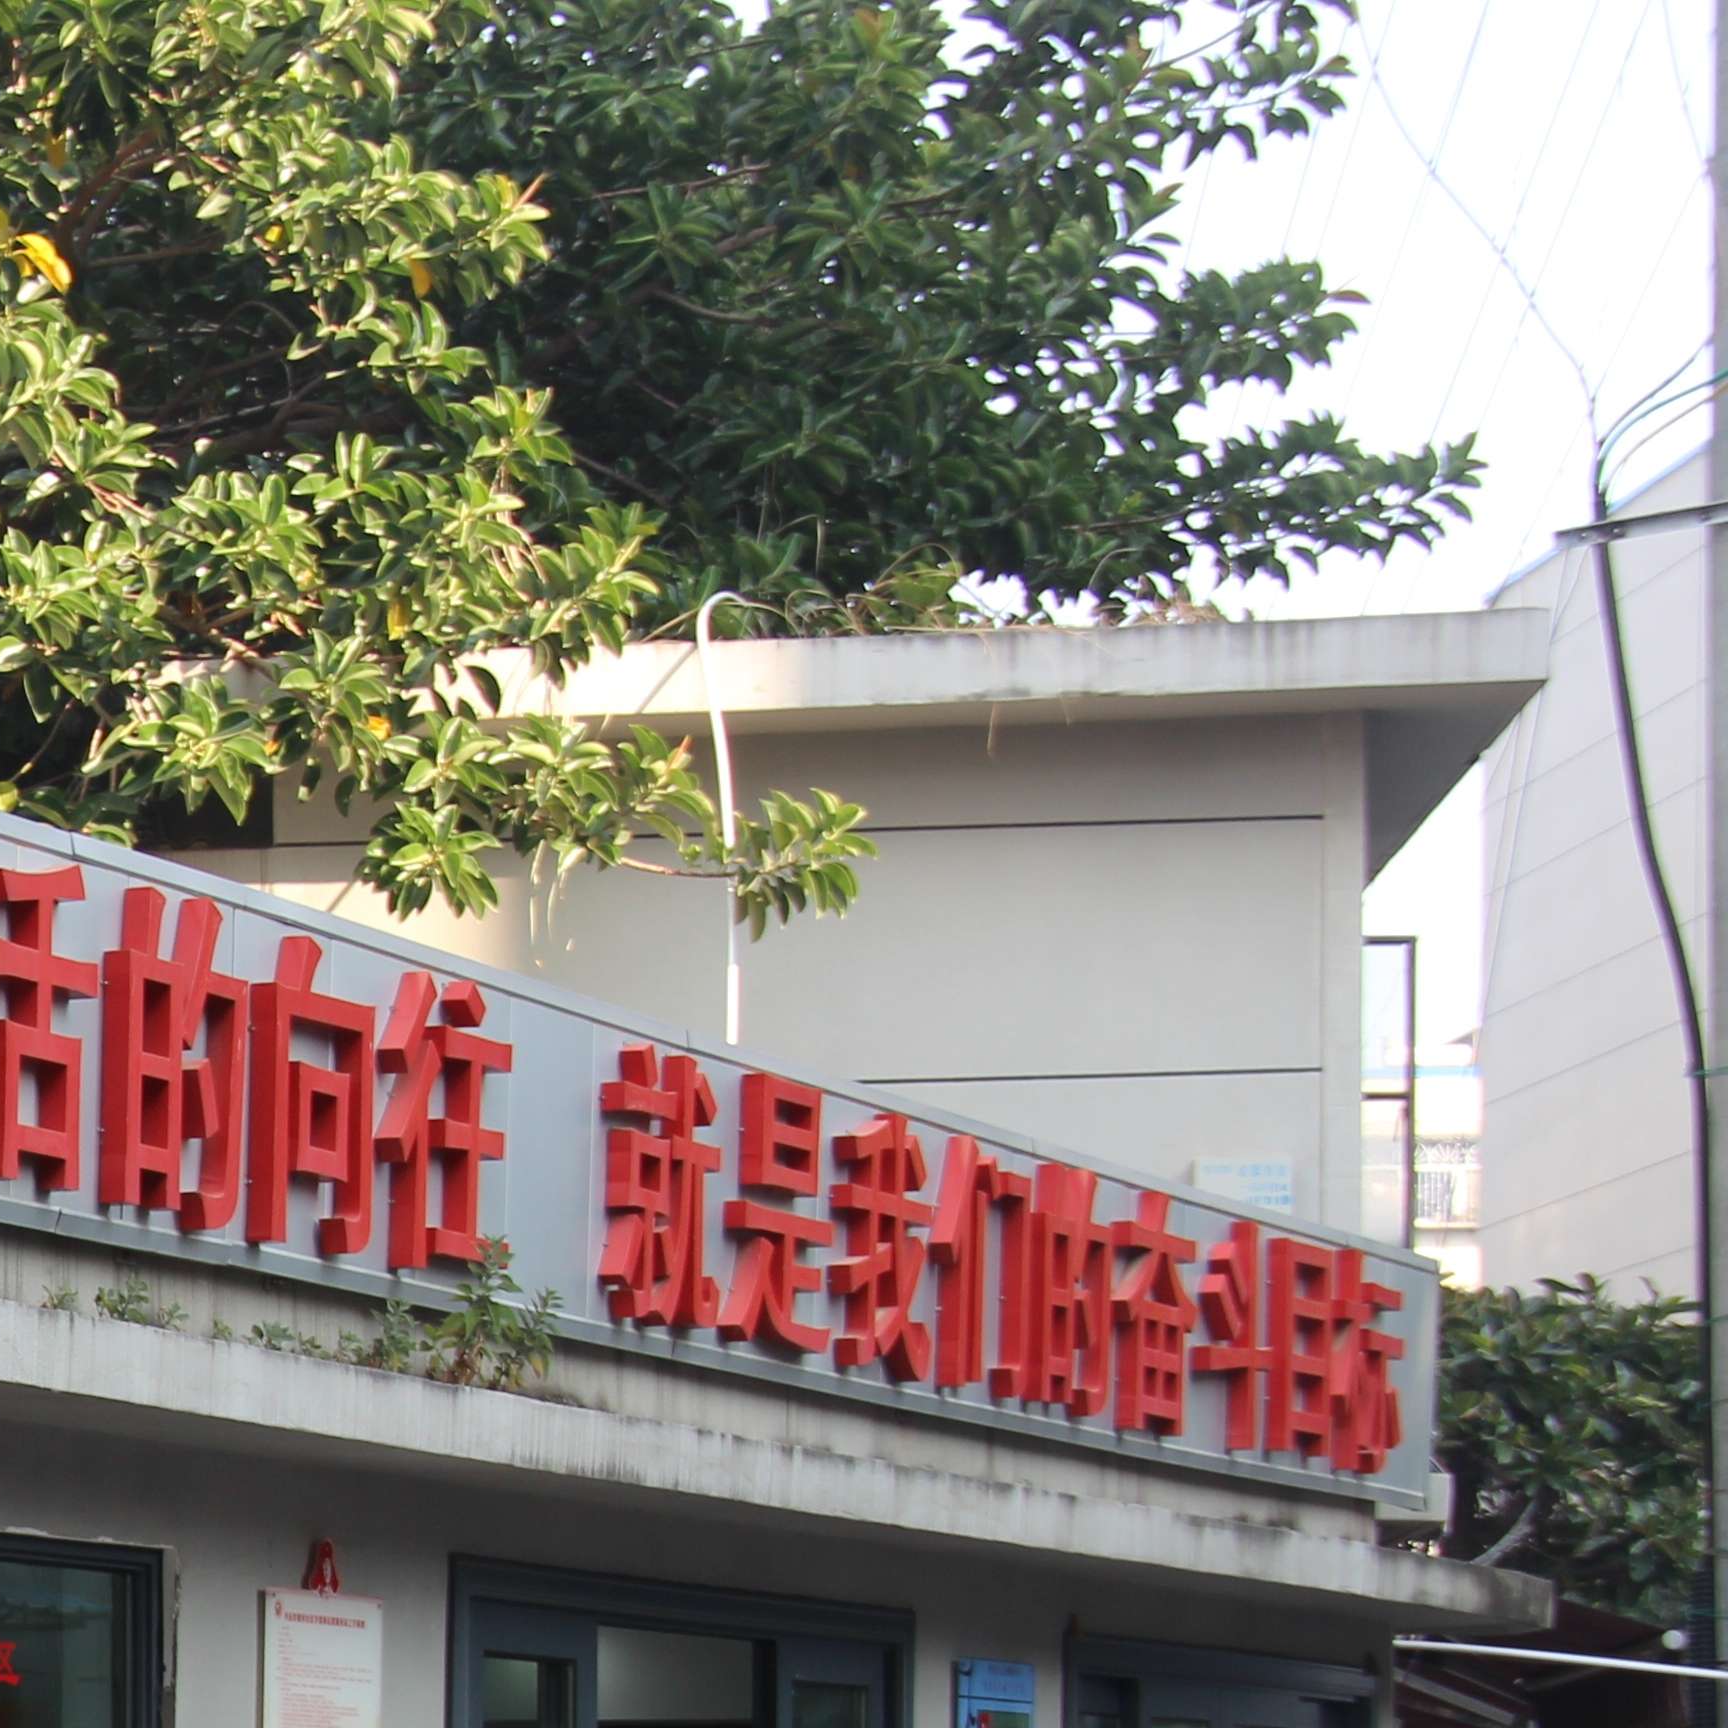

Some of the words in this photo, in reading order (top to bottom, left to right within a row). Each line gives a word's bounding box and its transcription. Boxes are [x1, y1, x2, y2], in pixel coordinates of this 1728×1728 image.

[598, 1042, 1406, 1474] 就是我们的奋斗目标
